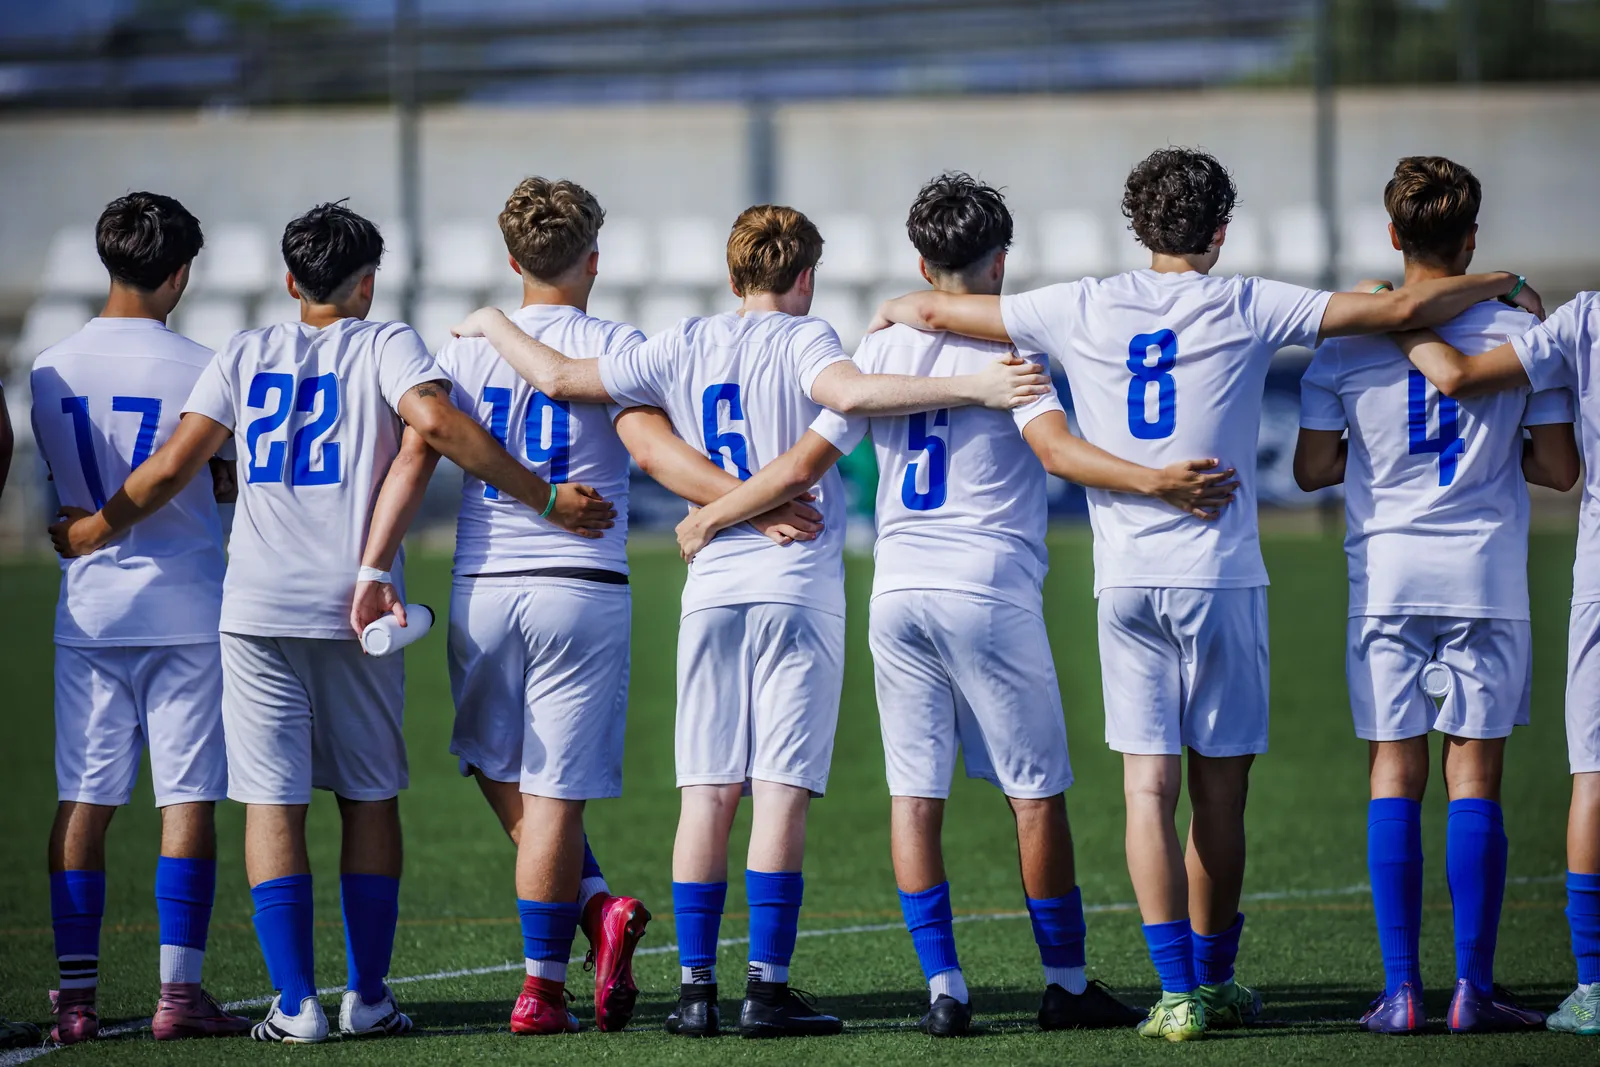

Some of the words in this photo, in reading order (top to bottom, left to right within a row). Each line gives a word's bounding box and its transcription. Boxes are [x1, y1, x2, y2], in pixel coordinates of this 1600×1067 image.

[247, 372, 341, 487] 22
[702, 383, 753, 482] 6
[1127, 329, 1178, 440] 8
[1409, 370, 1466, 487] 4
[61, 396, 162, 511] 17
[484, 387, 571, 500] 19
[902, 408, 948, 511] 5
